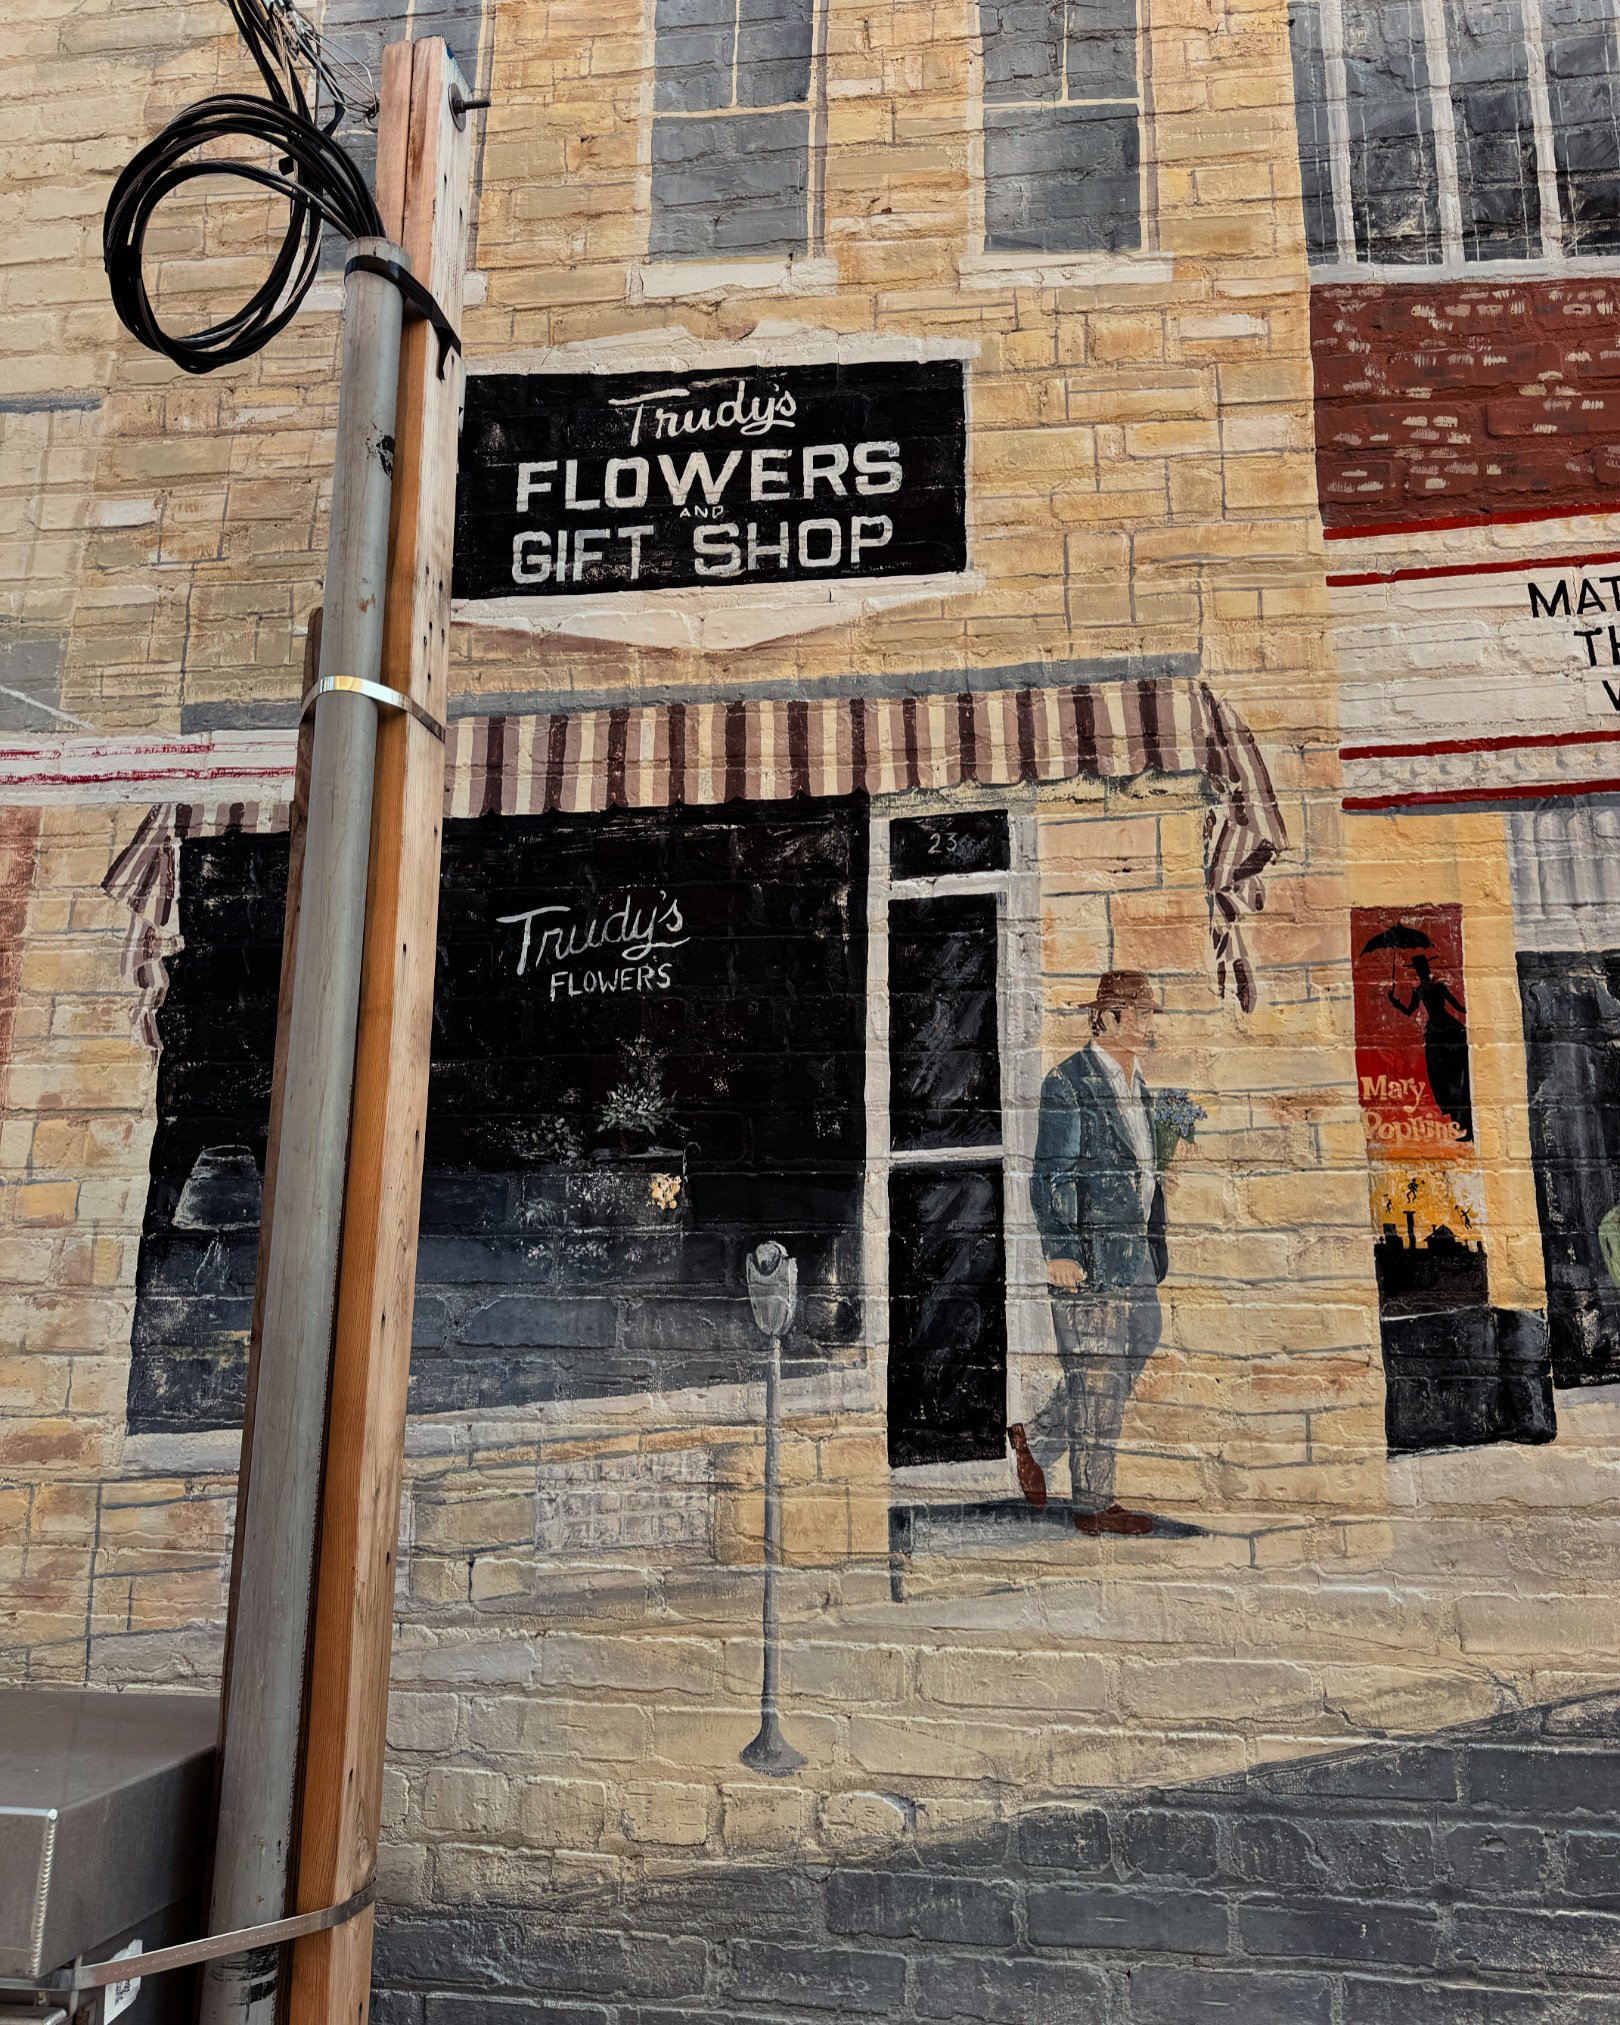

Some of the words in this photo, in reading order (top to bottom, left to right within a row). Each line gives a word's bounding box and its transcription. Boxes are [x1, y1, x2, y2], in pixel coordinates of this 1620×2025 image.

[609, 381, 797, 446] Trudy's
[516, 441, 902, 512] FLOWERS
[679, 505, 725, 518] AND
[511, 526, 654, 584] GIFT
[694, 515, 893, 577] SHOP
[928, 832, 958, 854] 23
[496, 890, 691, 975] Trudy's
[550, 963, 672, 1001] FLOWERS
[1360, 1075, 1426, 1113] Mary
